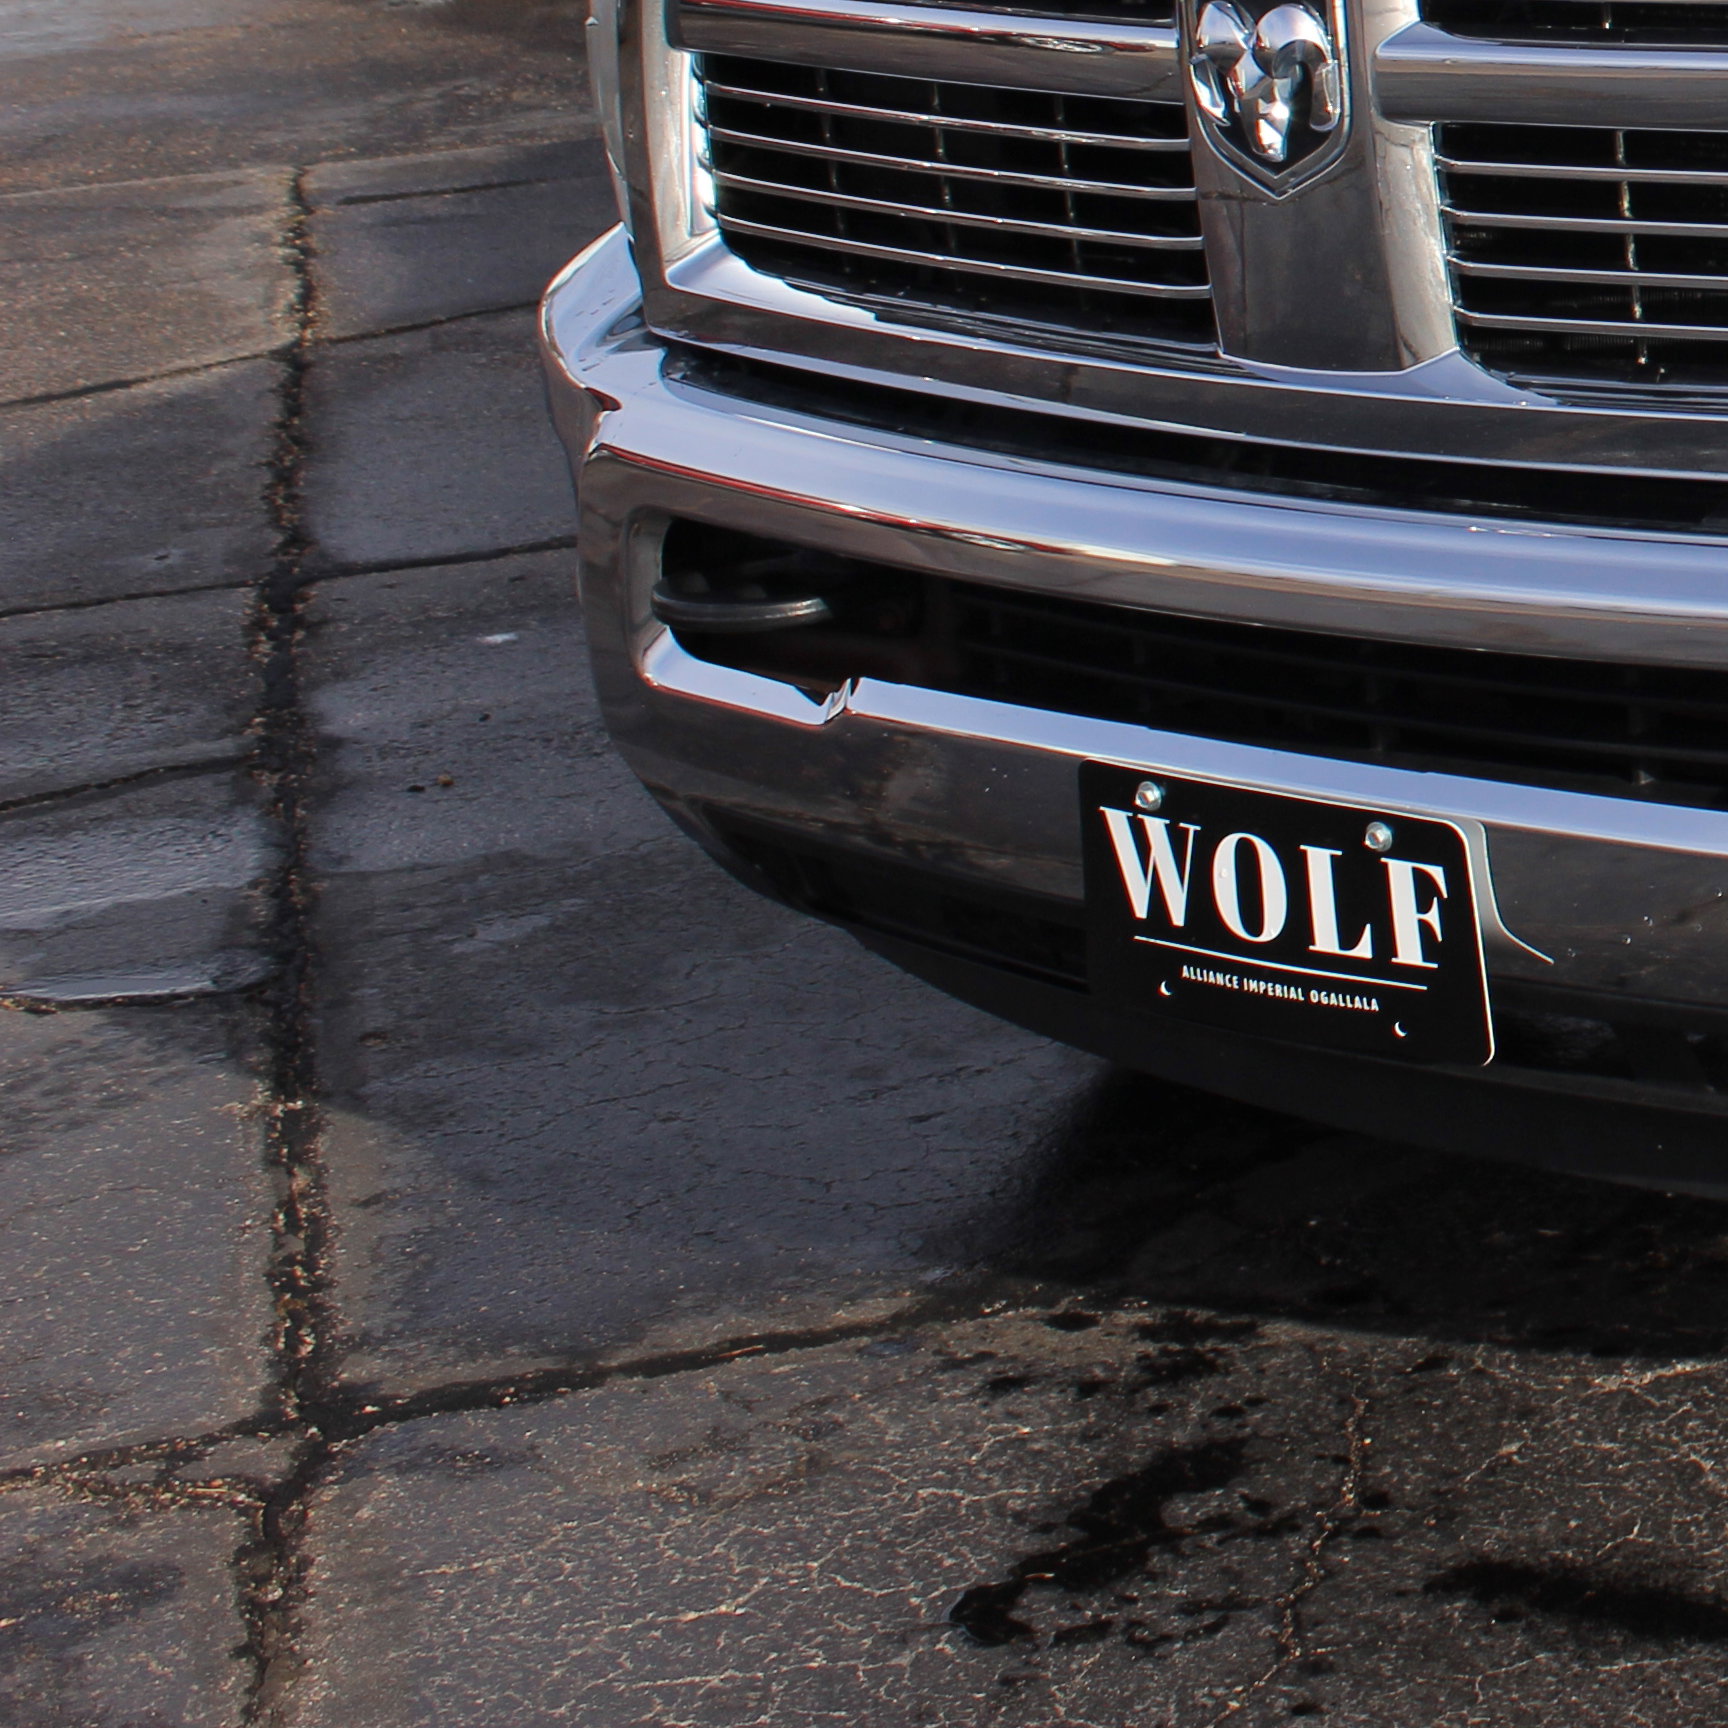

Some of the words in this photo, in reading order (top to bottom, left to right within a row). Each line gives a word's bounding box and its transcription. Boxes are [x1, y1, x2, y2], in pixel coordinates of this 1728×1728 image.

[1100, 807, 1448, 969] WOLF
[1181, 964, 1239, 990] ALLIANCE
[1243, 978, 1305, 1002] IMPERIAL
[1309, 989, 1380, 1012] OGALLALA
